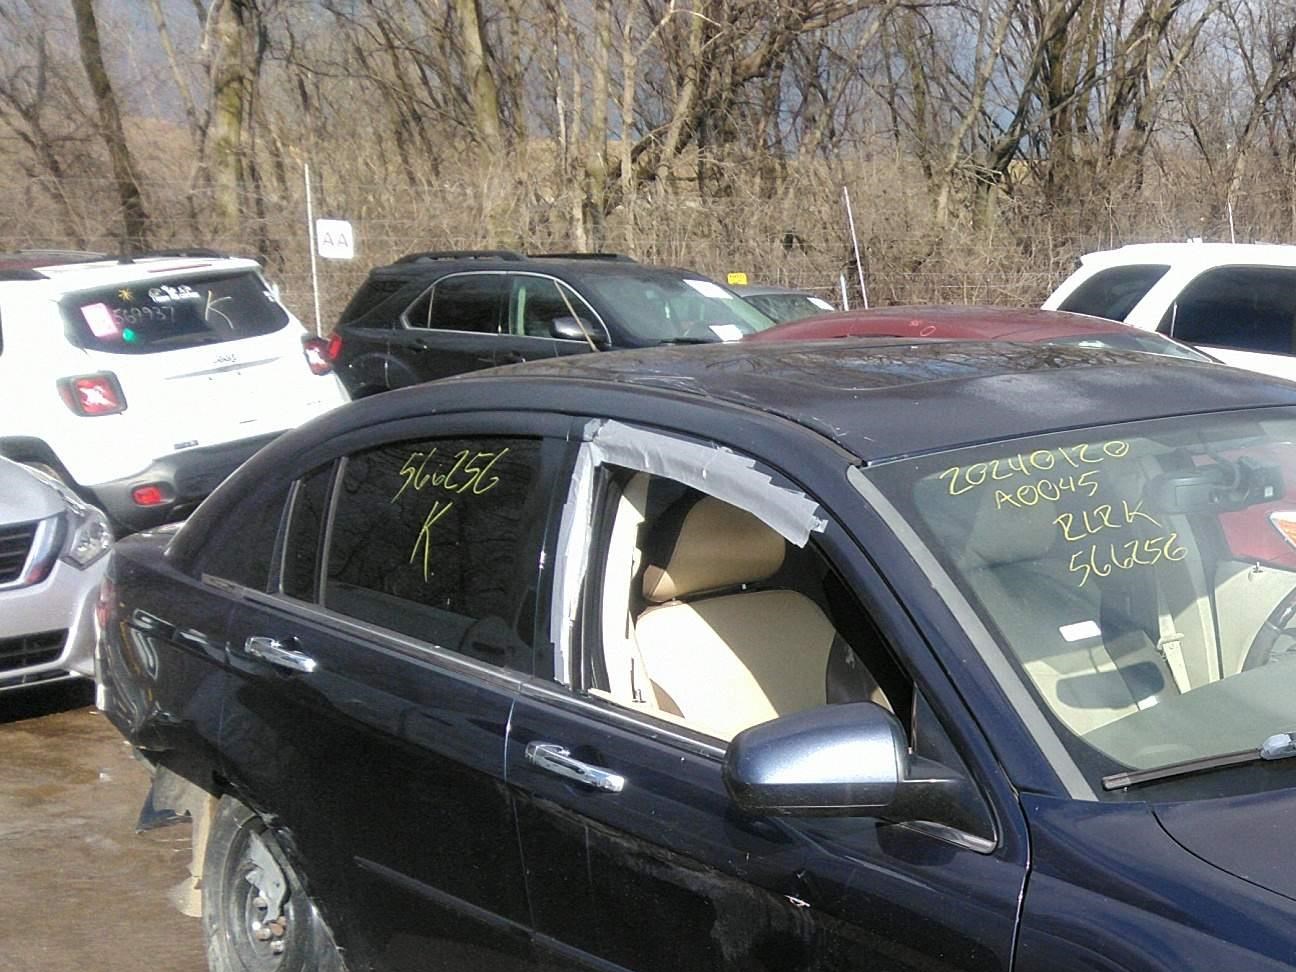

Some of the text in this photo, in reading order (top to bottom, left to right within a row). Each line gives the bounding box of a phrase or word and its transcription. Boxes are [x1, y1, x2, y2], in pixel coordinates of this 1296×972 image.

[390, 447, 510, 504] 566256
[939, 440, 1130, 496] 20240120
[994, 470, 1100, 510] A0045
[409, 500, 454, 583] K
[1068, 532, 1189, 588] 566256
